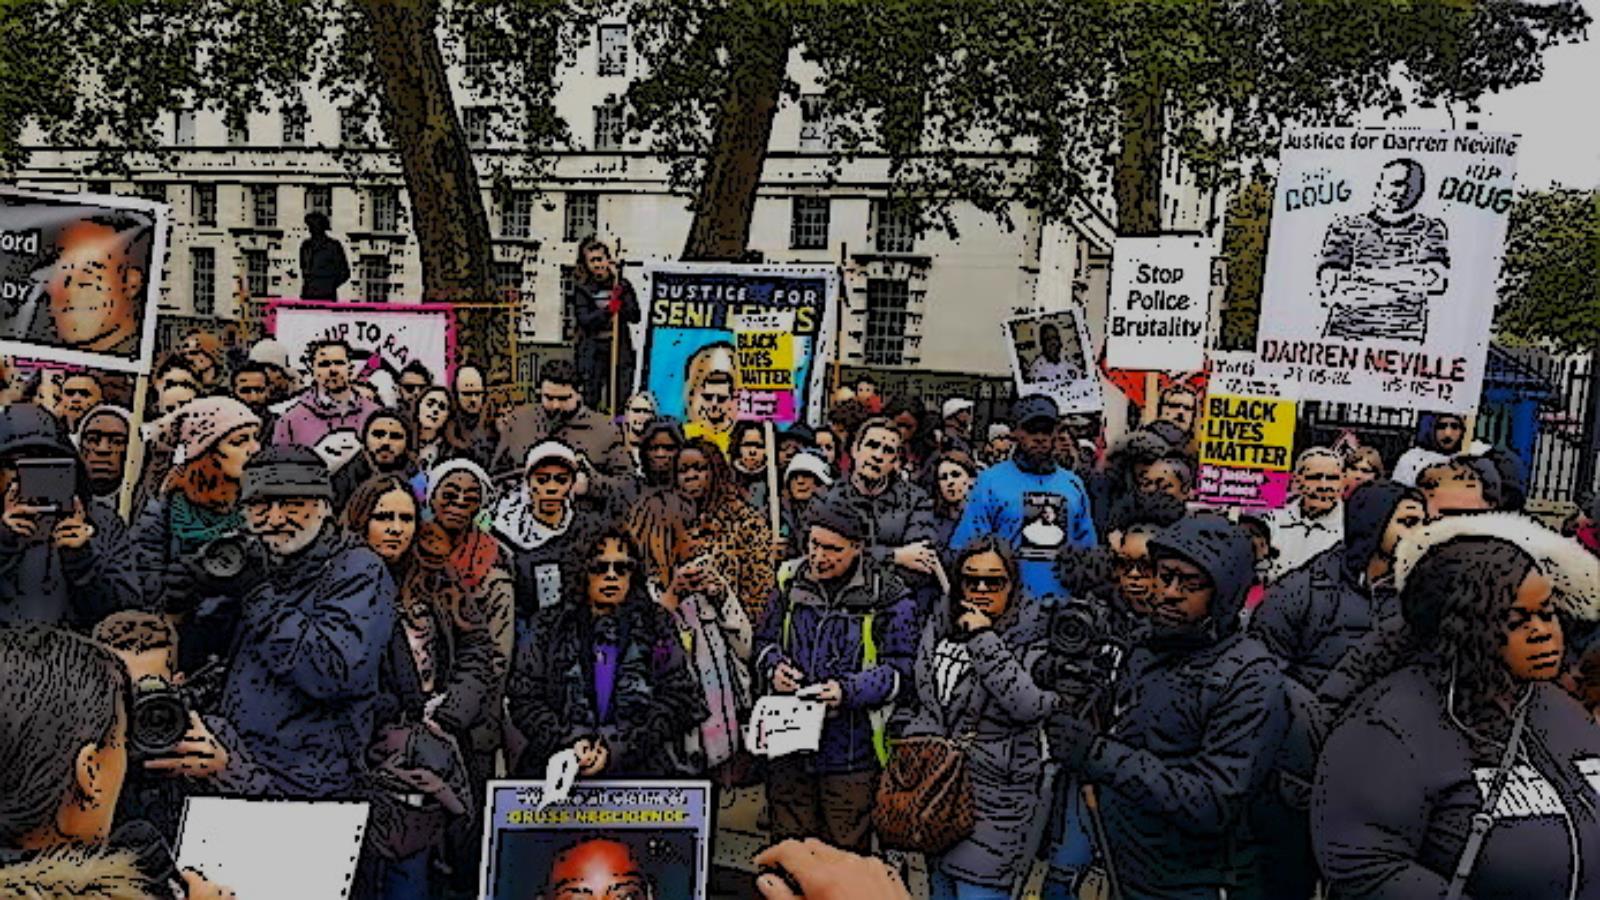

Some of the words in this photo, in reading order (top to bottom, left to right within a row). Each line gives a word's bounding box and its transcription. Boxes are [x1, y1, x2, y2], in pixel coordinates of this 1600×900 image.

[1284, 132, 1345, 150] Justice
[1350, 131, 1380, 149] for
[1383, 133, 1449, 153] Darren
[1454, 134, 1518, 157] Neville
[1438, 176, 1513, 214] DOUG
[0, 234, 38, 253] ord
[1136, 263, 1184, 284] Stop
[656, 282, 748, 301] JUSTICE
[773, 289, 818, 305] FOR
[1127, 290, 1191, 310] Police
[652, 299, 714, 327] SENI
[355, 320, 382, 344] TO
[1111, 316, 1202, 337] Brutality
[1260, 340, 1359, 370] DARREN
[1364, 346, 1468, 382] NEVILLE
[1208, 397, 1278, 424] BLACK
[1207, 420, 1265, 442] LIVES
[1204, 441, 1288, 466] MATTER
